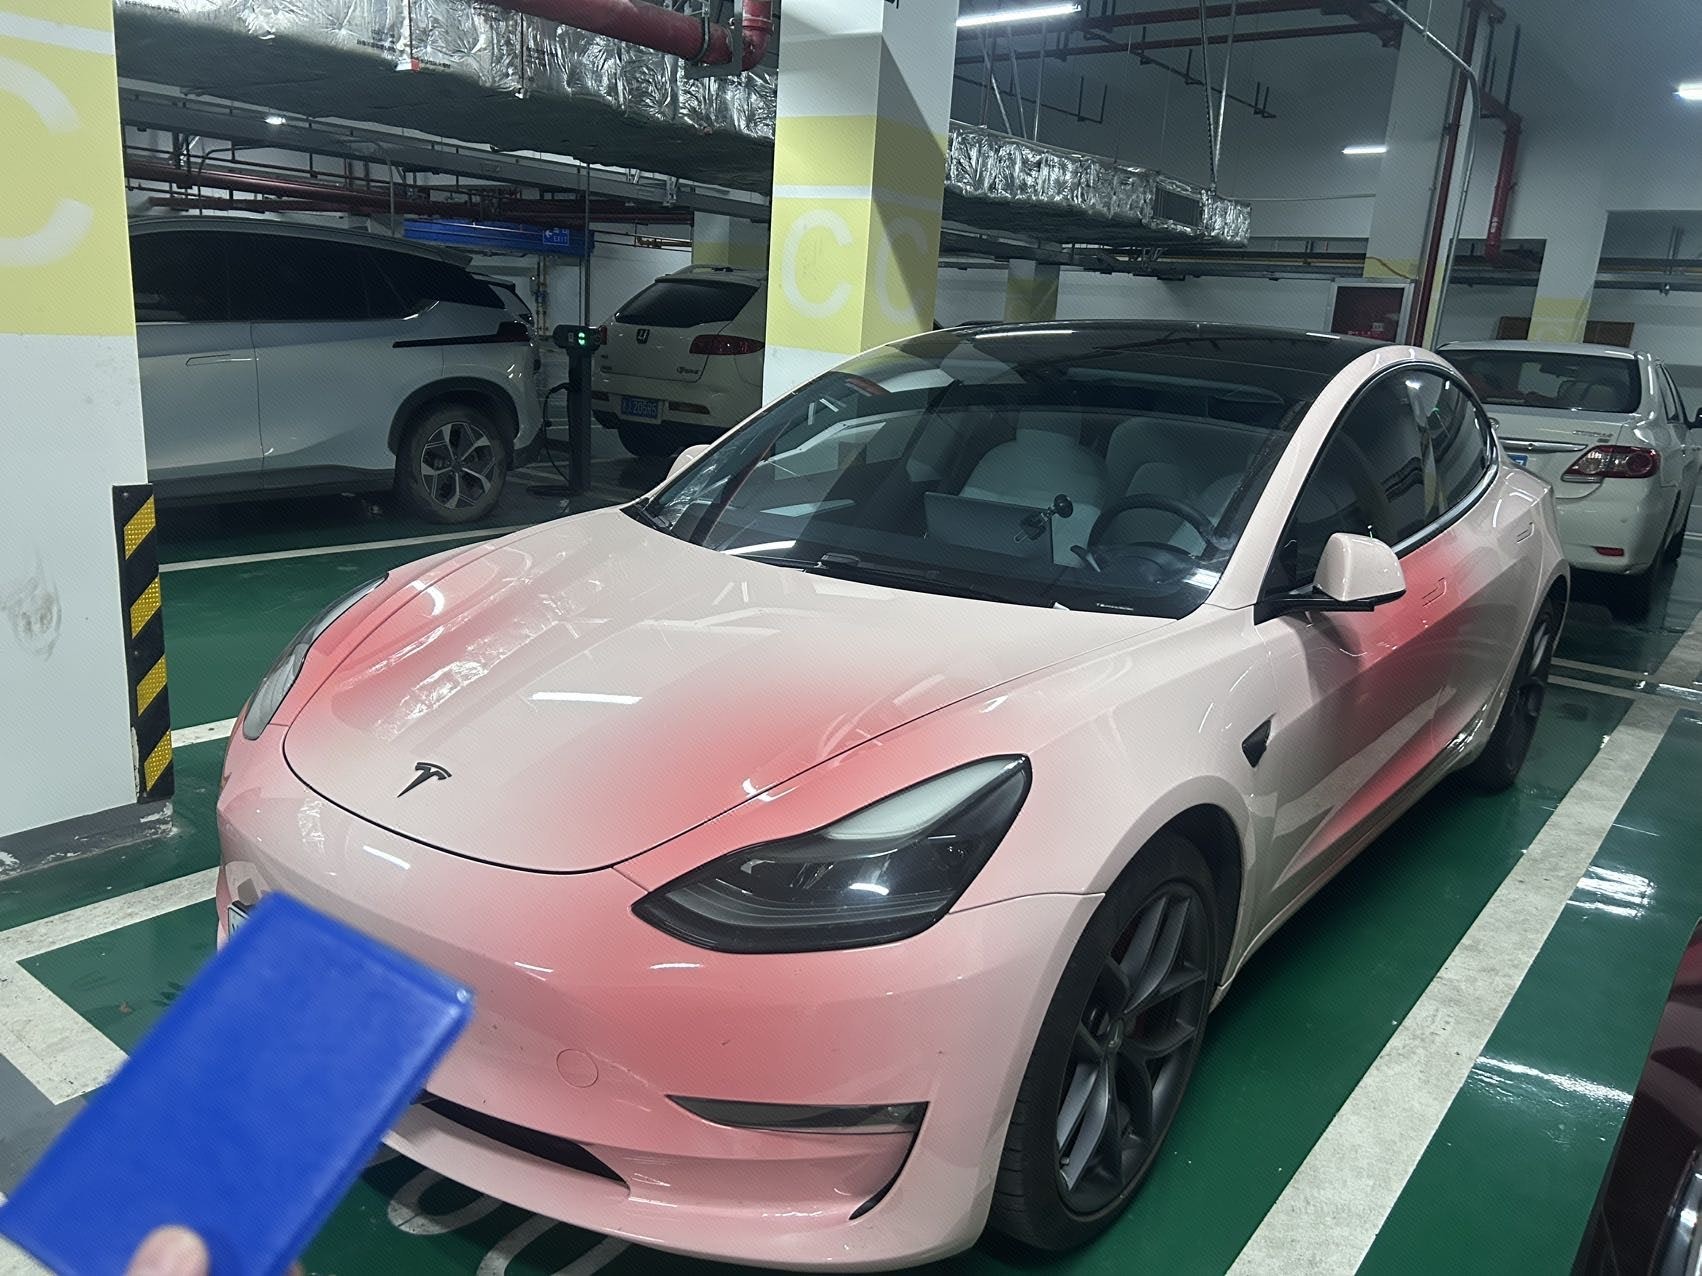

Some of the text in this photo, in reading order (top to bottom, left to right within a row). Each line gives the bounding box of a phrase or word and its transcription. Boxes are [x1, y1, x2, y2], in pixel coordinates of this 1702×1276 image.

[553, 235, 567, 243] EXIT
[781, 208, 854, 318] C
[874, 217, 928, 325] C
